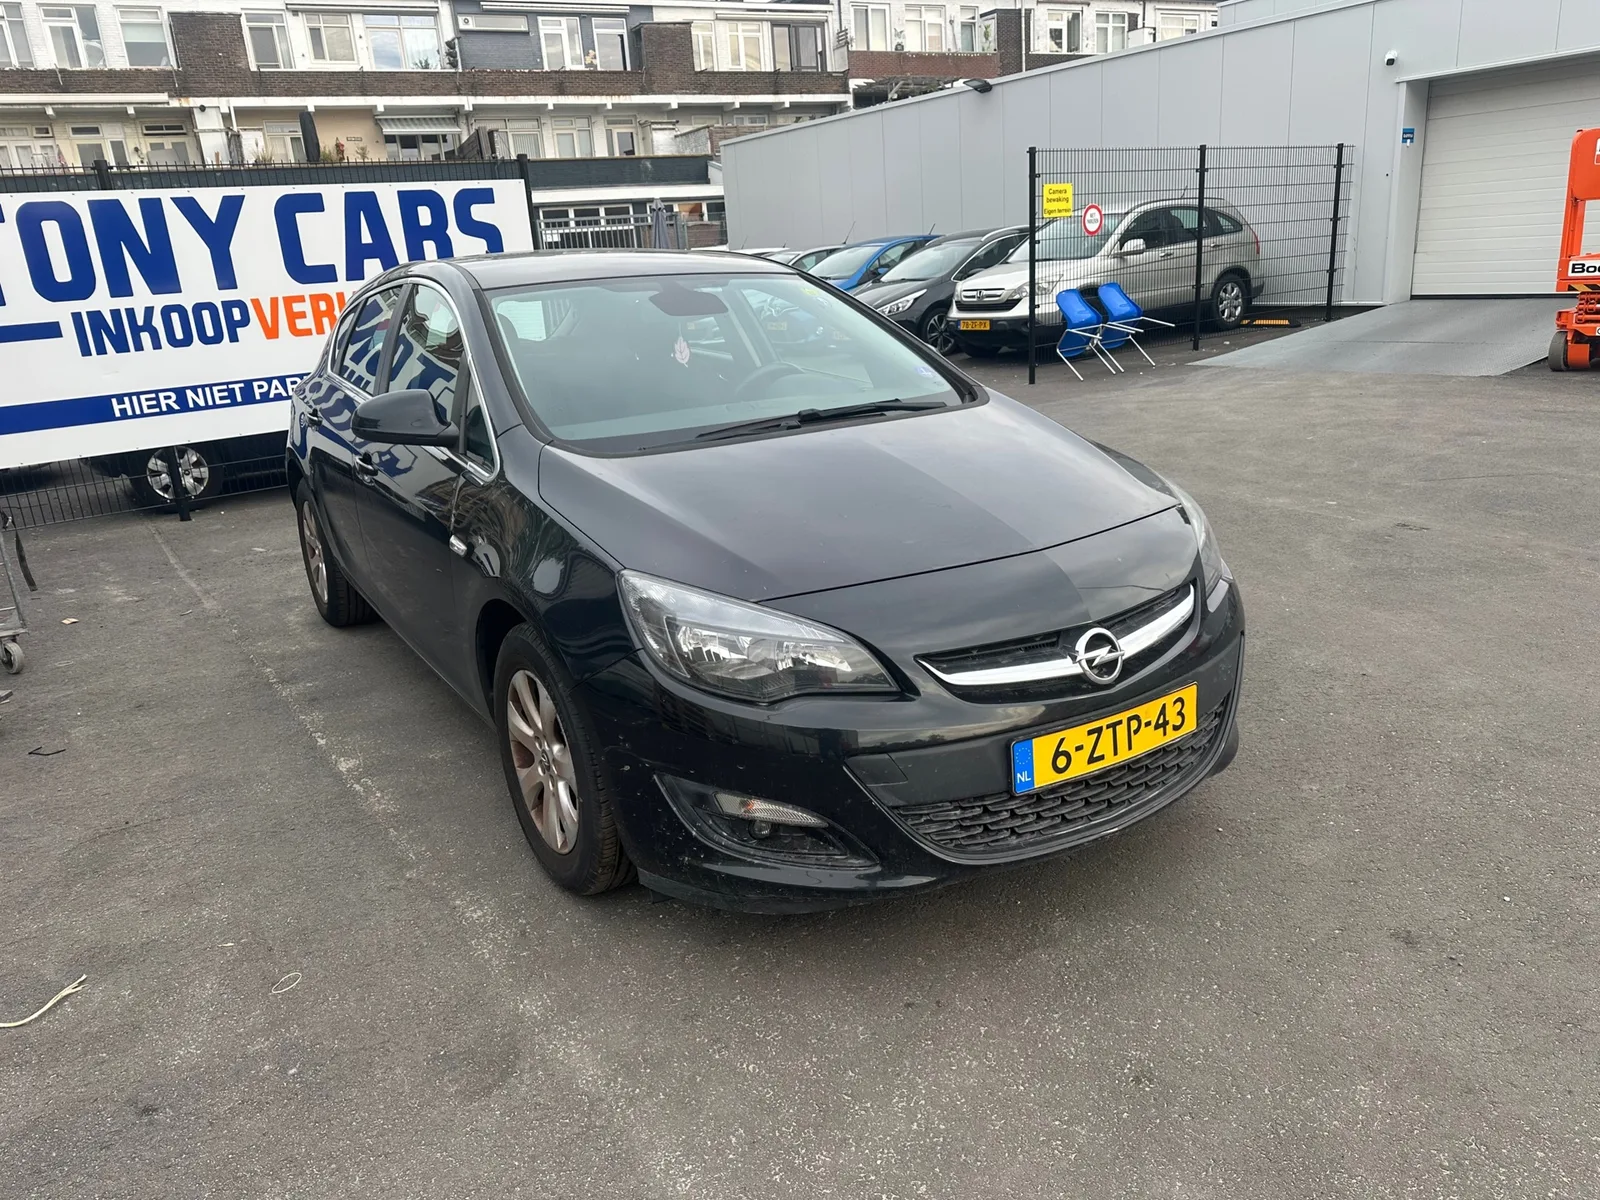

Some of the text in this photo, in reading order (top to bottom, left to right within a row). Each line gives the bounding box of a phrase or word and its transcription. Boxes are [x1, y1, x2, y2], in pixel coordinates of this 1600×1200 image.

[1046, 196, 1069, 204] bewaking
[0, 187, 504, 306] ONY CARS
[1571, 262, 1600, 274] Bo
[71, 291, 356, 357] INKOOPVER
[111, 391, 181, 418] HIER
[185, 383, 244, 408] NIET
[1051, 696, 1186, 775] 6-ZTP-43
[1016, 770, 1032, 783] NL
